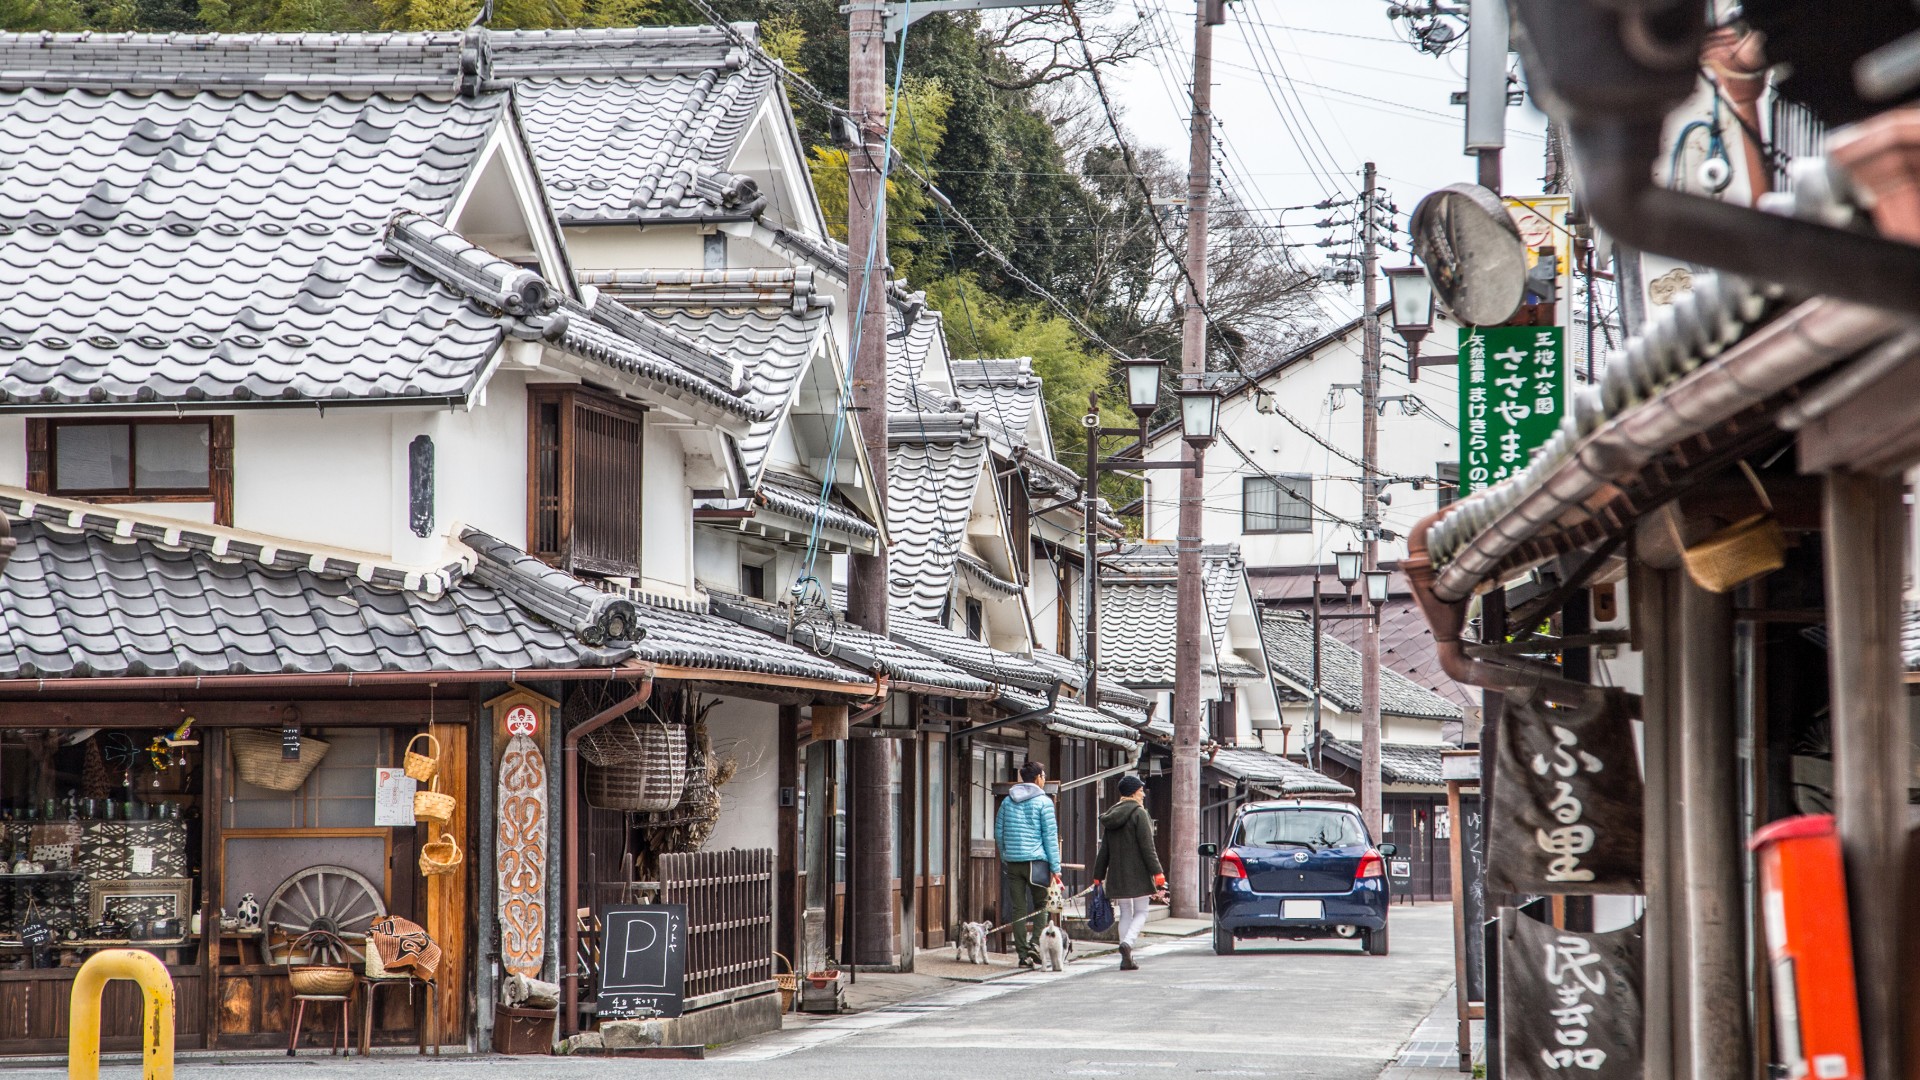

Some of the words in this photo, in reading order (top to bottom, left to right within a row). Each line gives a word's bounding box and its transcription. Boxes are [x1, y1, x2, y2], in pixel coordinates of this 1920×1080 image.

[379, 771, 391, 788] P
[1531, 725, 1604, 883] ふる里
[622, 919, 657, 979] P
[1541, 936, 1607, 1071] 民芸品
